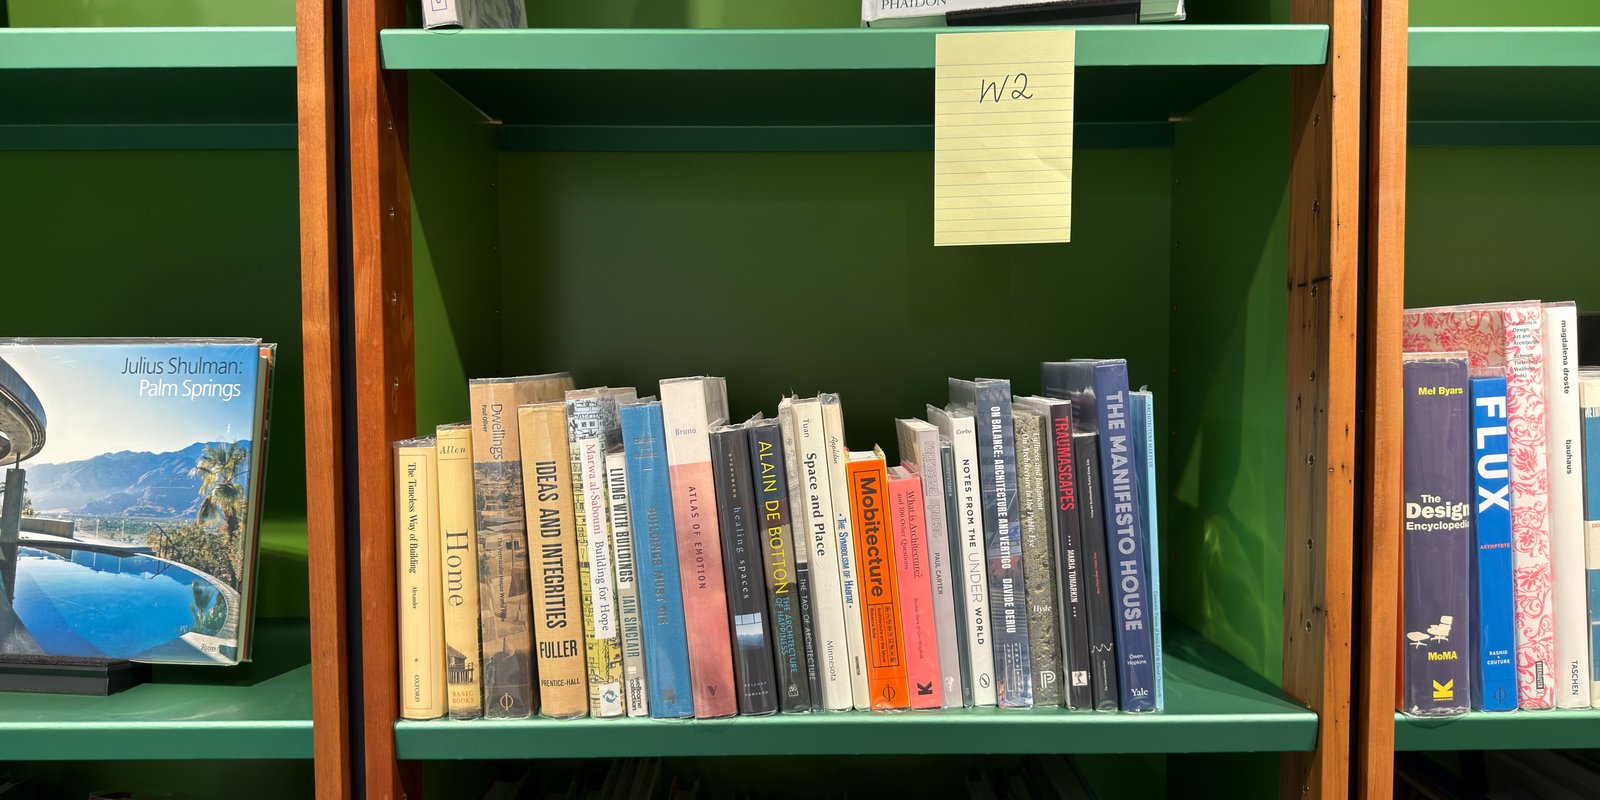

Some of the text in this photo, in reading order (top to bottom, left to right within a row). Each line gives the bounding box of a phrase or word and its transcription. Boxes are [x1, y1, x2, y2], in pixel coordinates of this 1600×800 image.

[1560, 320, 1568, 366] magdalena
[121, 356, 243, 376] Julius Shulman:
[139, 378, 241, 401] Palm Springs
[1418, 386, 1463, 396] Mel Byars
[440, 446, 466, 454] Allen
[490, 403, 506, 460] Dwellings
[675, 428, 696, 436] Bruno
[1022, 433, 1029, 444] On
[1023, 448, 1031, 489] Architecture
[1055, 416, 1075, 511] TRAUMASCAPES
[1476, 396, 1512, 514] FLUX
[586, 444, 600, 534] Marwa al-Sabouni
[804, 452, 826, 556] Space and Place
[908, 491, 916, 512] What
[924, 442, 944, 538] repressed spaces
[990, 406, 1012, 569] ON BALANCE: ARCHITECTURE AND VERTIGO
[1420, 494, 1441, 503] The
[408, 462, 418, 574] The Timeless Way of Building
[610, 468, 633, 583] LIVING WITH BUILDINGS
[758, 441, 789, 594] ALAIN DE BOTTON
[838, 518, 846, 529] THE
[1027, 511, 1035, 534] Public
[1105, 391, 1143, 630] THE MANIFESTO HOUSE
[1406, 502, 1470, 521] Design
[536, 461, 567, 629] IDEAS AND INTEGRITIES
[647, 506, 662, 568] BUILDINGS
[688, 486, 707, 589] ATLAS OF EMOTION
[734, 506, 749, 599] healing spaces
[839, 532, 849, 569] SYMBOLISM
[860, 477, 883, 597] Mobitecture
[901, 539, 909, 570] Questions
[910, 525, 922, 579] Architecture?
[962, 459, 984, 645] NOTES FROM THE UNDER WORLD
[1027, 535, 1036, 548] Eye
[446, 529, 469, 606] Home
[594, 541, 609, 632] Building for Hope
[653, 570, 665, 602] MUST
[1067, 550, 1078, 603] MARIA TUMARKIN
[844, 581, 853, 604] HABITAT
[1003, 579, 1013, 606] DAVIDE
[1033, 604, 1052, 614] Hyde
[622, 595, 639, 658] IAIN SINCLAIR
[776, 598, 788, 655] OF HAPPINESS
[803, 614, 810, 624] OF
[1005, 608, 1016, 633] DERIU
[540, 640, 578, 658] FULLER
[784, 615, 798, 673] ARCHITECTURE
[804, 627, 816, 680] ARCHITECTURE
[827, 640, 836, 682] Minnesota
[1428, 651, 1458, 660] MoMA
[541, 678, 580, 687] PRENTICE-HALL
[634, 676, 642, 708] wellcome
[1131, 688, 1149, 698] Yale
[1432, 678, 1454, 698] K
